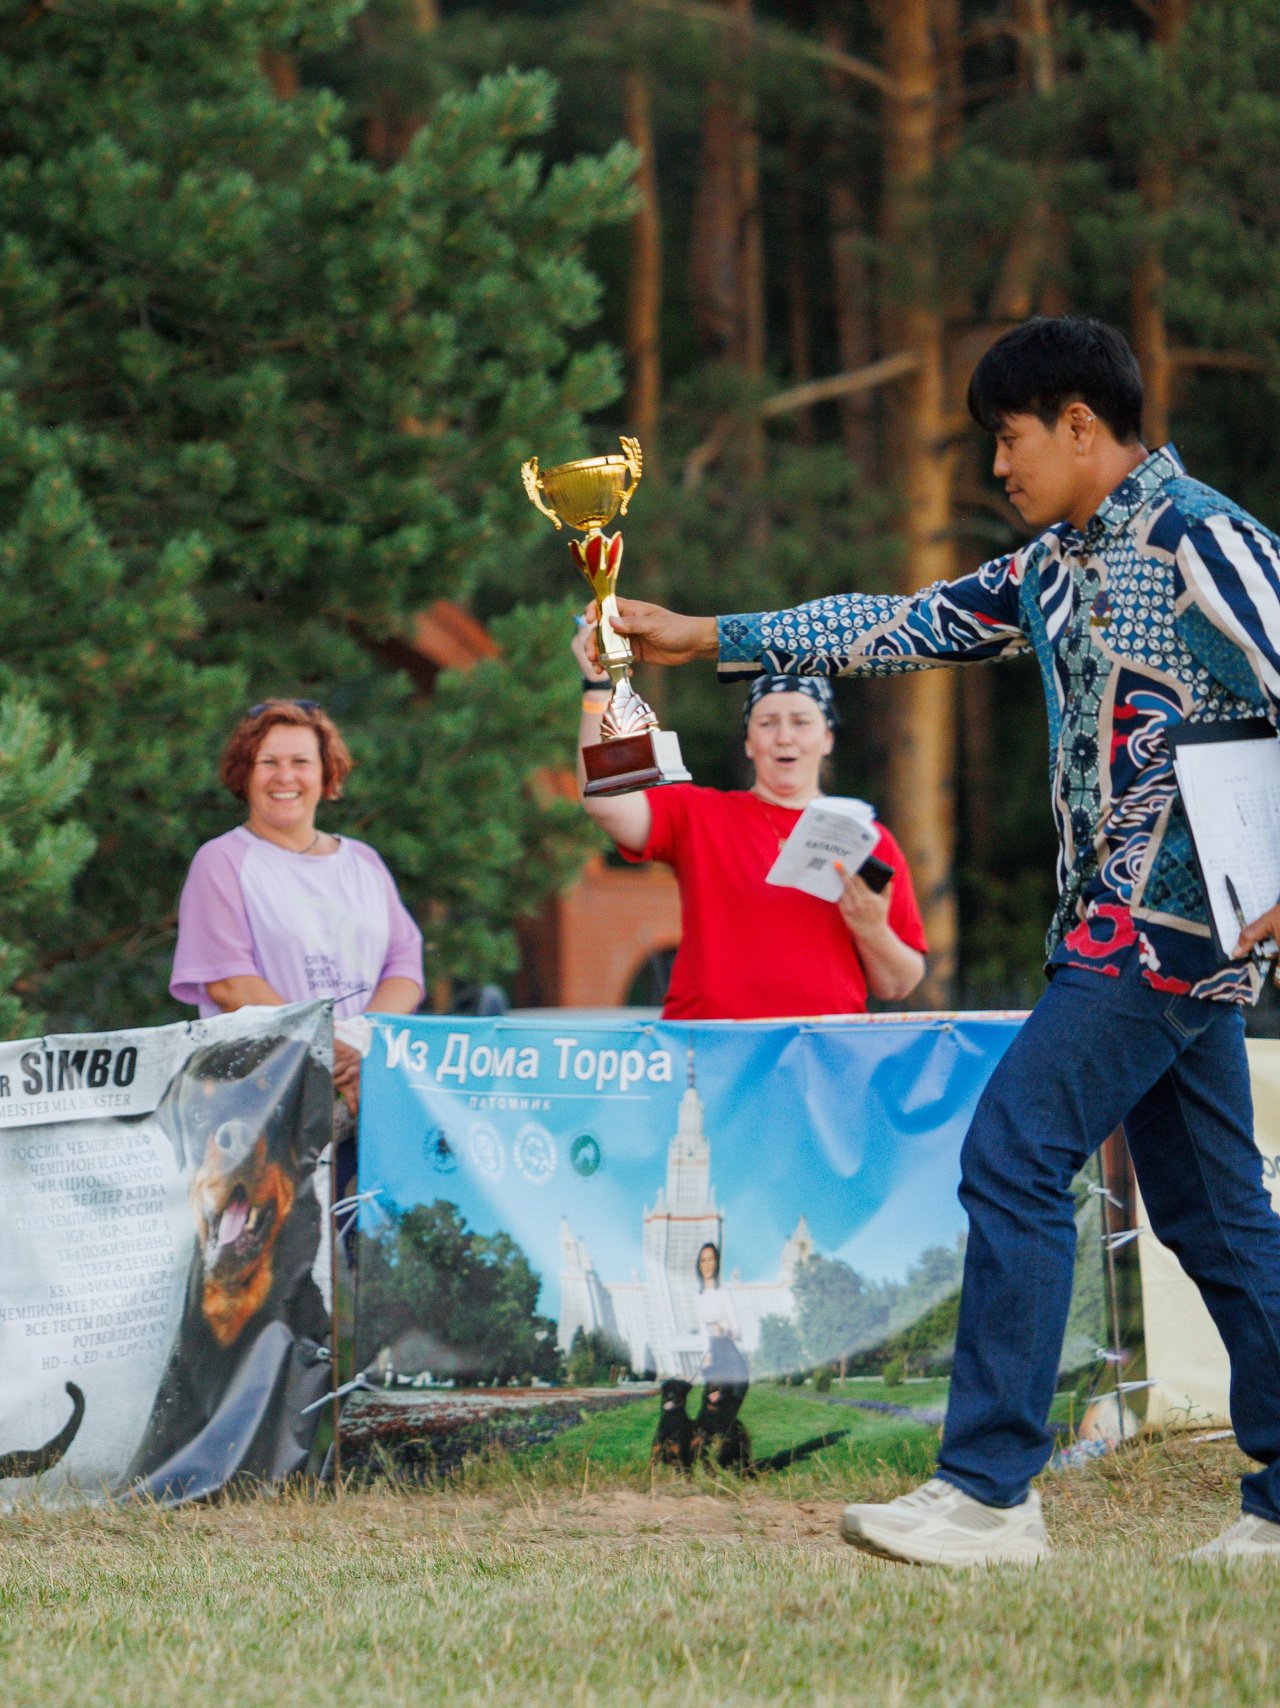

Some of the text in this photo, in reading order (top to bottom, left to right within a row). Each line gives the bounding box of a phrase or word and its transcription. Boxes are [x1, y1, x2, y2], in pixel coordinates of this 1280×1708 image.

[20, 1047, 138, 1095] SIMBO
[385, 1026, 672, 1091] Из Дома Торра
[52, 1098, 77, 1113] MIA
[10, 1143, 64, 1161] РОССИИ,
[66, 1136, 124, 1154] ЧЕМПИОН
[126, 1134, 152, 1149] РКФ
[30, 1150, 158, 1176] ЧЕМПИОН БЕЛАРУСИ
[48, 1166, 163, 1193] НАЦИОНАЛЬНОГО
[50, 1183, 167, 1210] РОТВЕЙЛЕР КЛУБА
[48, 1208, 107, 1228] ЧЕМПИОН
[110, 1199, 164, 1220] РОССИИ
[137, 1218, 170, 1234] IGP-3
[82, 1234, 173, 1259] ПОЖИЗНЕННО
[62, 1252, 175, 1279] ПОДТВЕРЖДЕННАЯ
[49, 1275, 146, 1299] КВАЛИФИКАЦИЯ
[90, 1291, 138, 1311] РОССИИ
[25, 1322, 49, 1337] ВСЕ
[52, 1316, 93, 1334] ТЕСТЫ
[96, 1313, 113, 1328] ПО
[73, 1323, 147, 1349] РОТВЕЙЛЕРОВ
[42, 1356, 60, 1370] HD
[83, 1350, 98, 1364] ED
